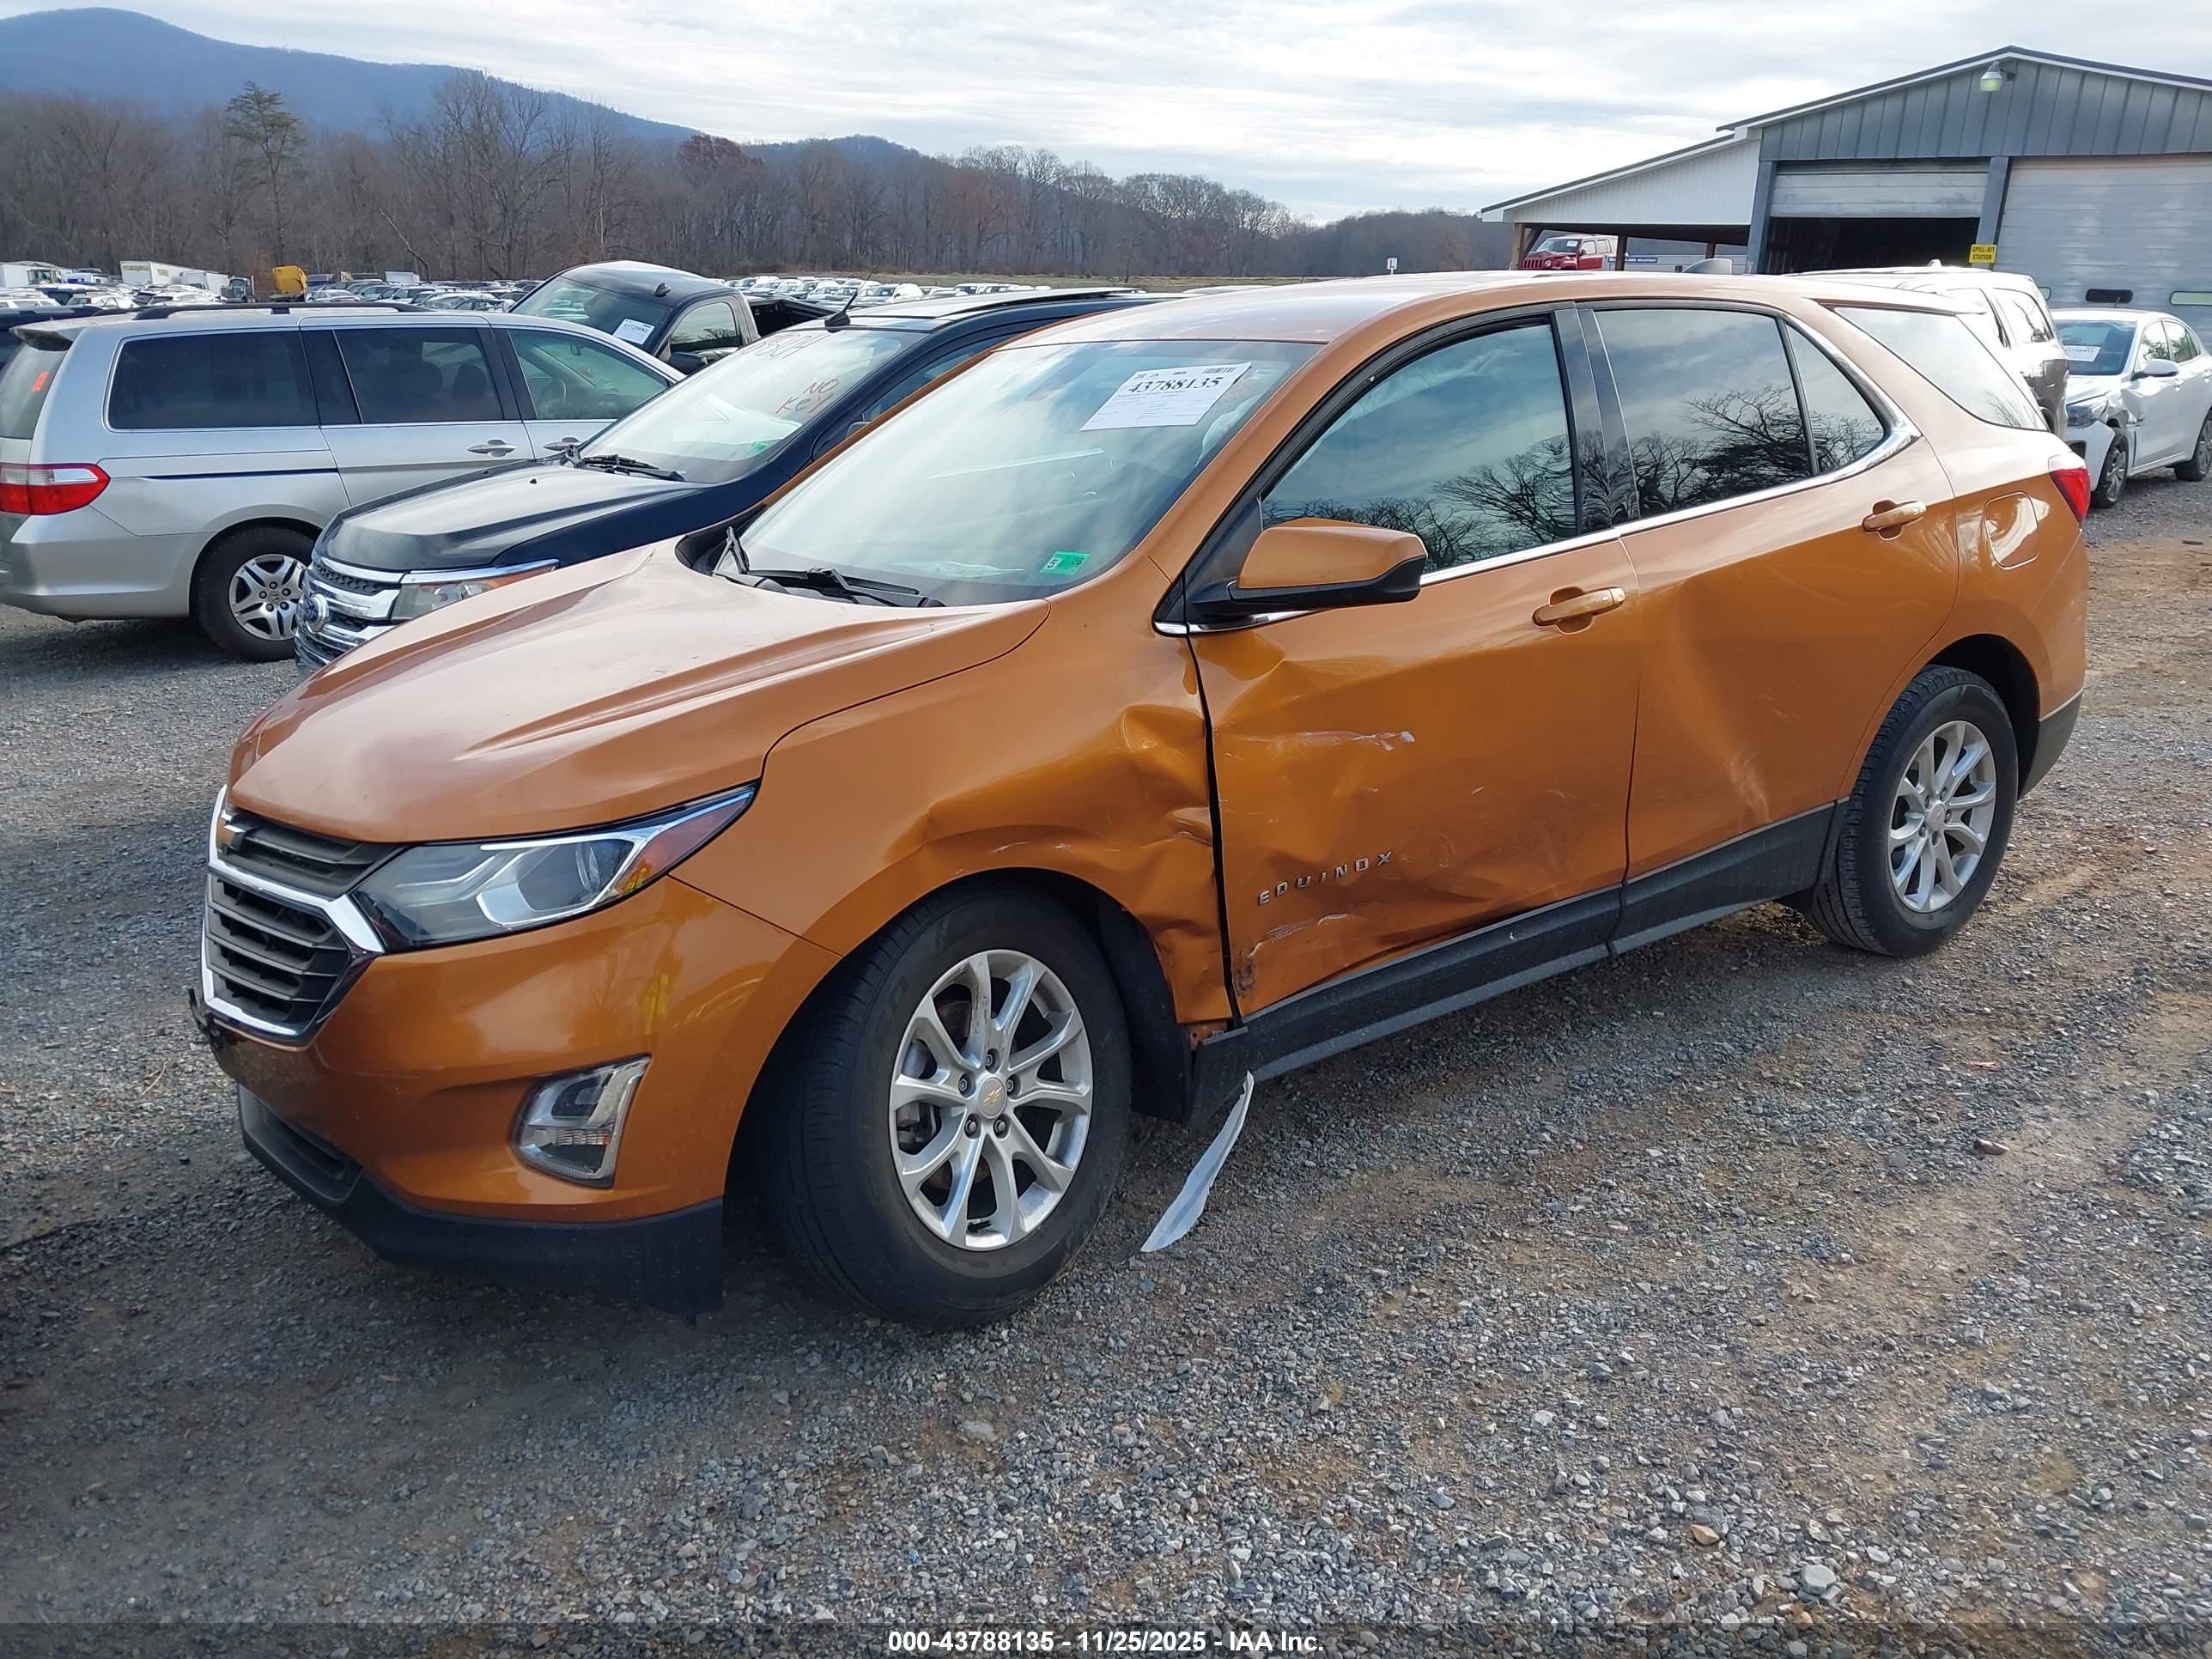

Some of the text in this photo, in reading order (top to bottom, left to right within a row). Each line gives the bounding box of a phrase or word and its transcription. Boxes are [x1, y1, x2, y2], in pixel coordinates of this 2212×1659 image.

[803, 378, 838, 394] NO
[1127, 377, 1223, 392] 43788135
[1258, 851, 1392, 906] EQUINOX
